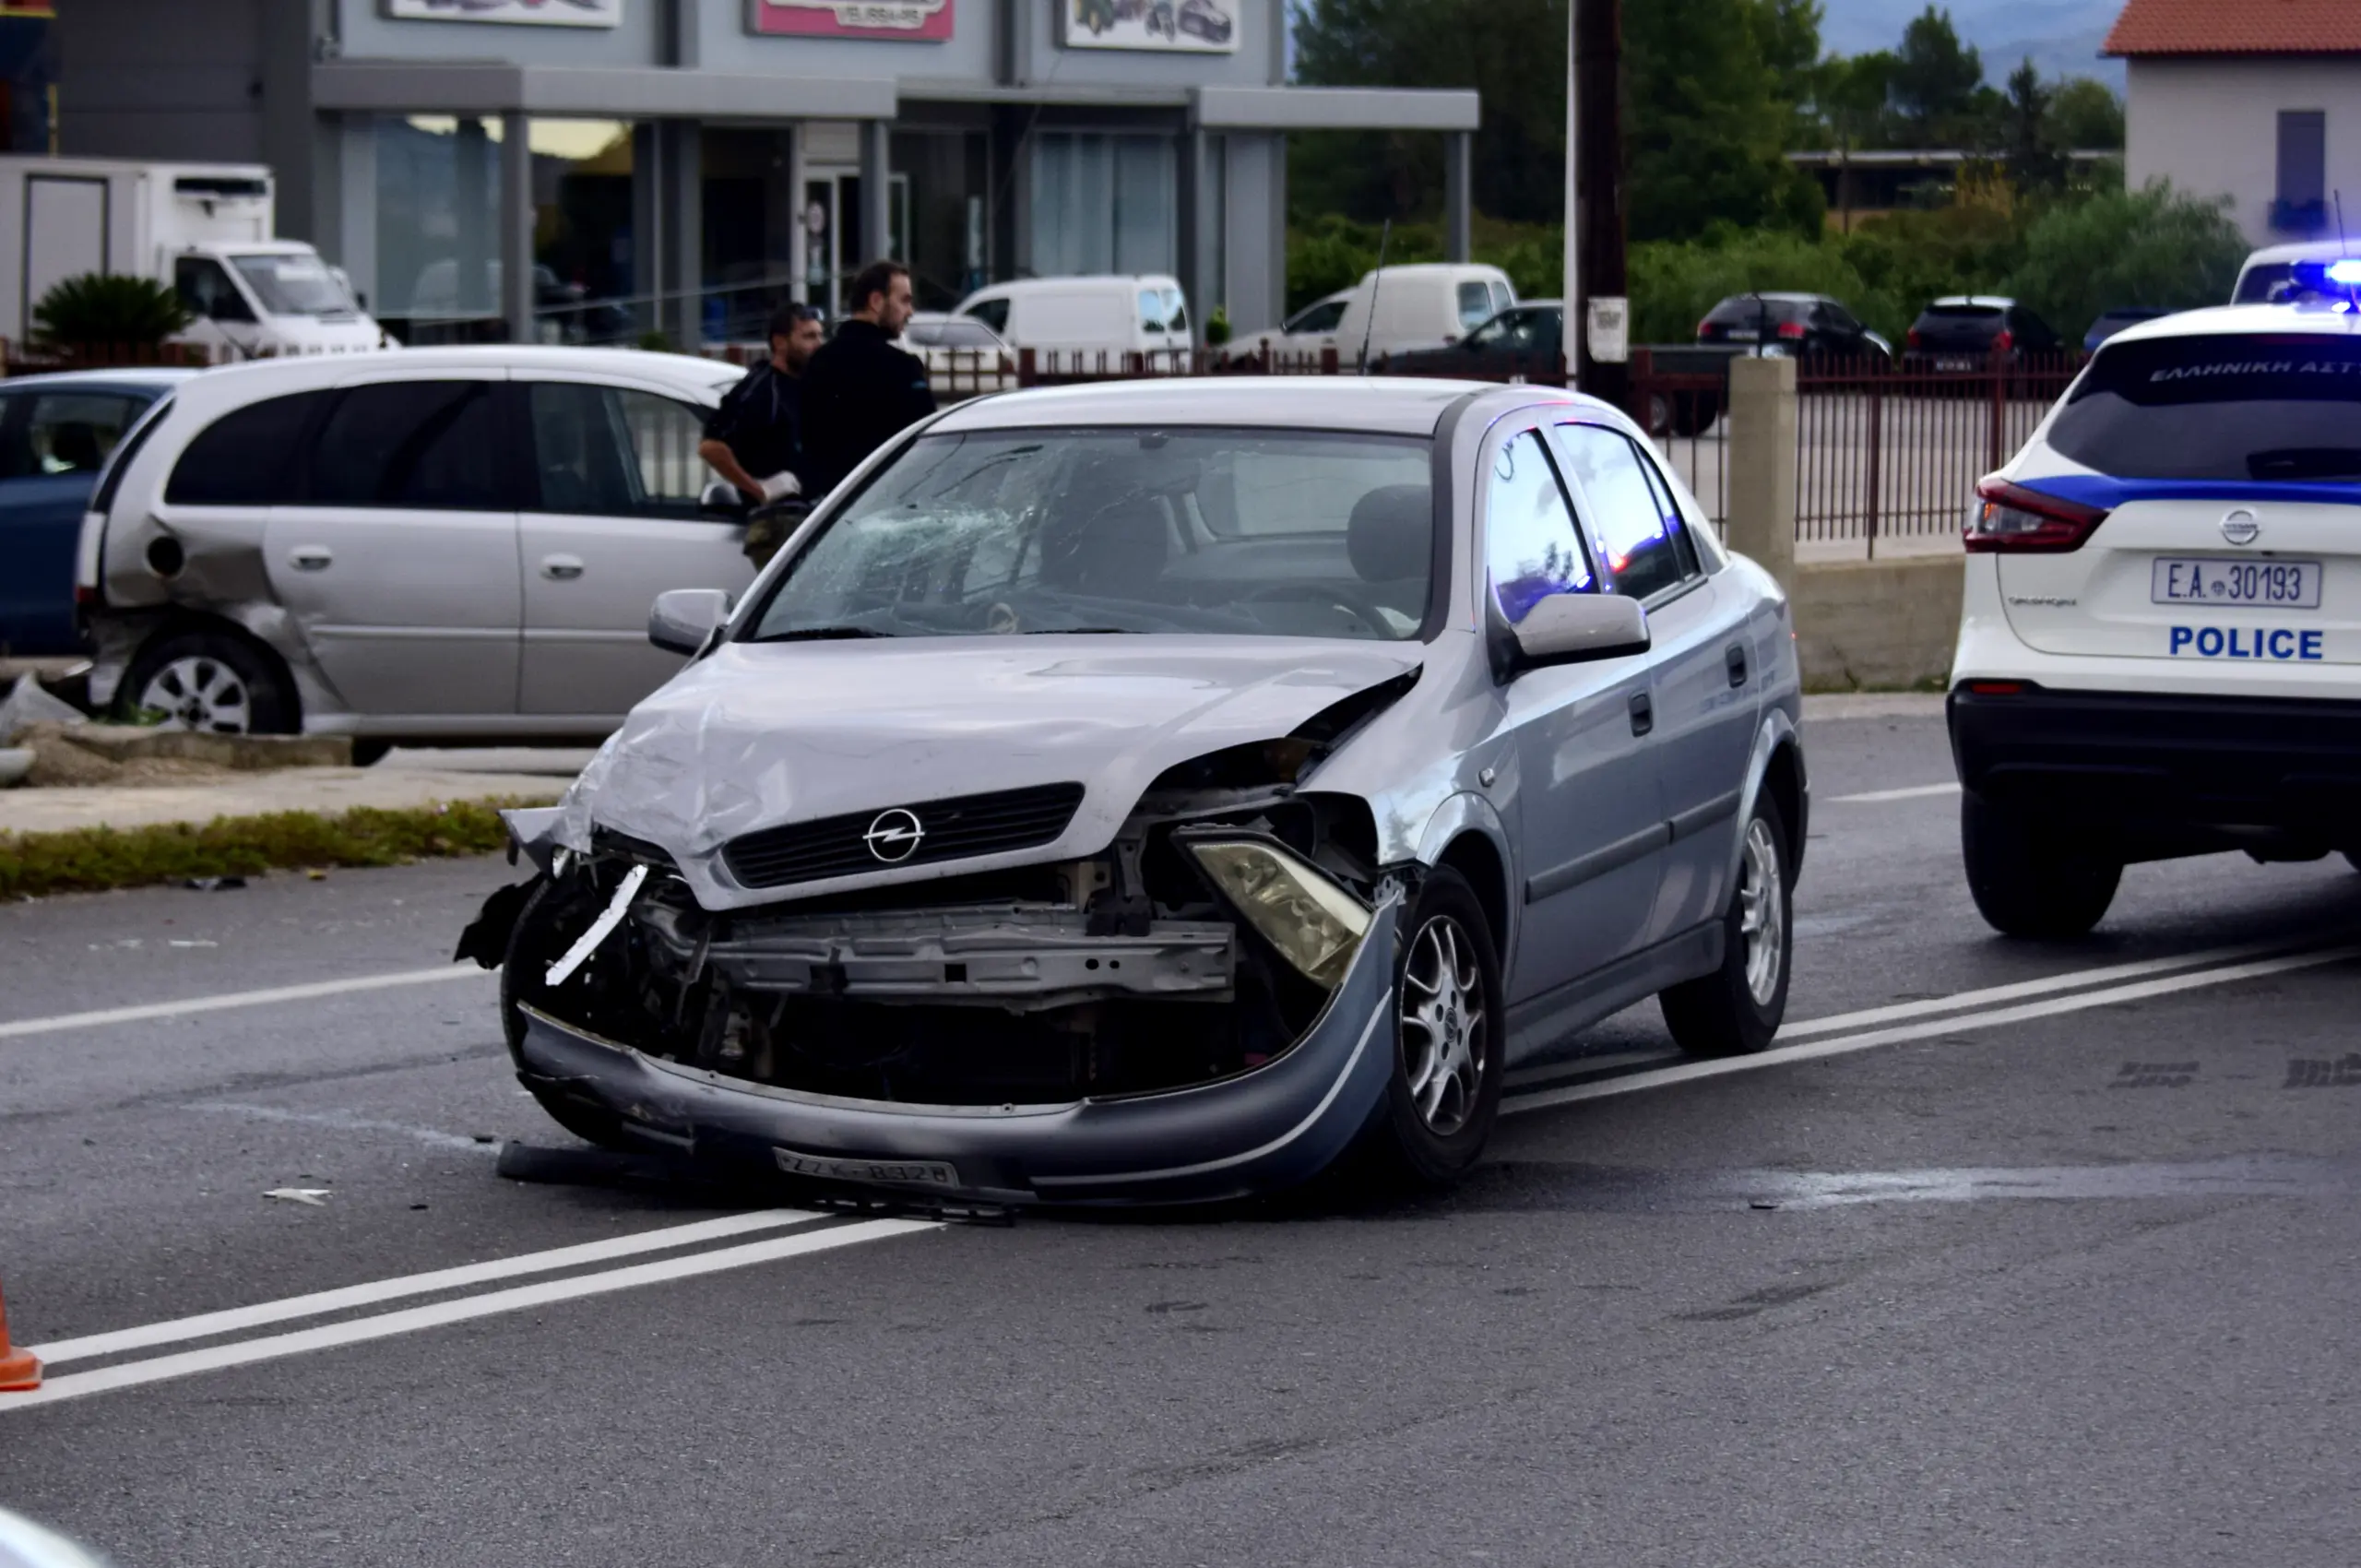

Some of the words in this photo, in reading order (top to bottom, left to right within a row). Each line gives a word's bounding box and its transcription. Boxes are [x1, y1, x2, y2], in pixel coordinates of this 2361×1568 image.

[2298, 361, 2361, 374] ΑΣΤ
[2228, 564, 2302, 600] 30193
[2169, 625, 2323, 659] POLICE
